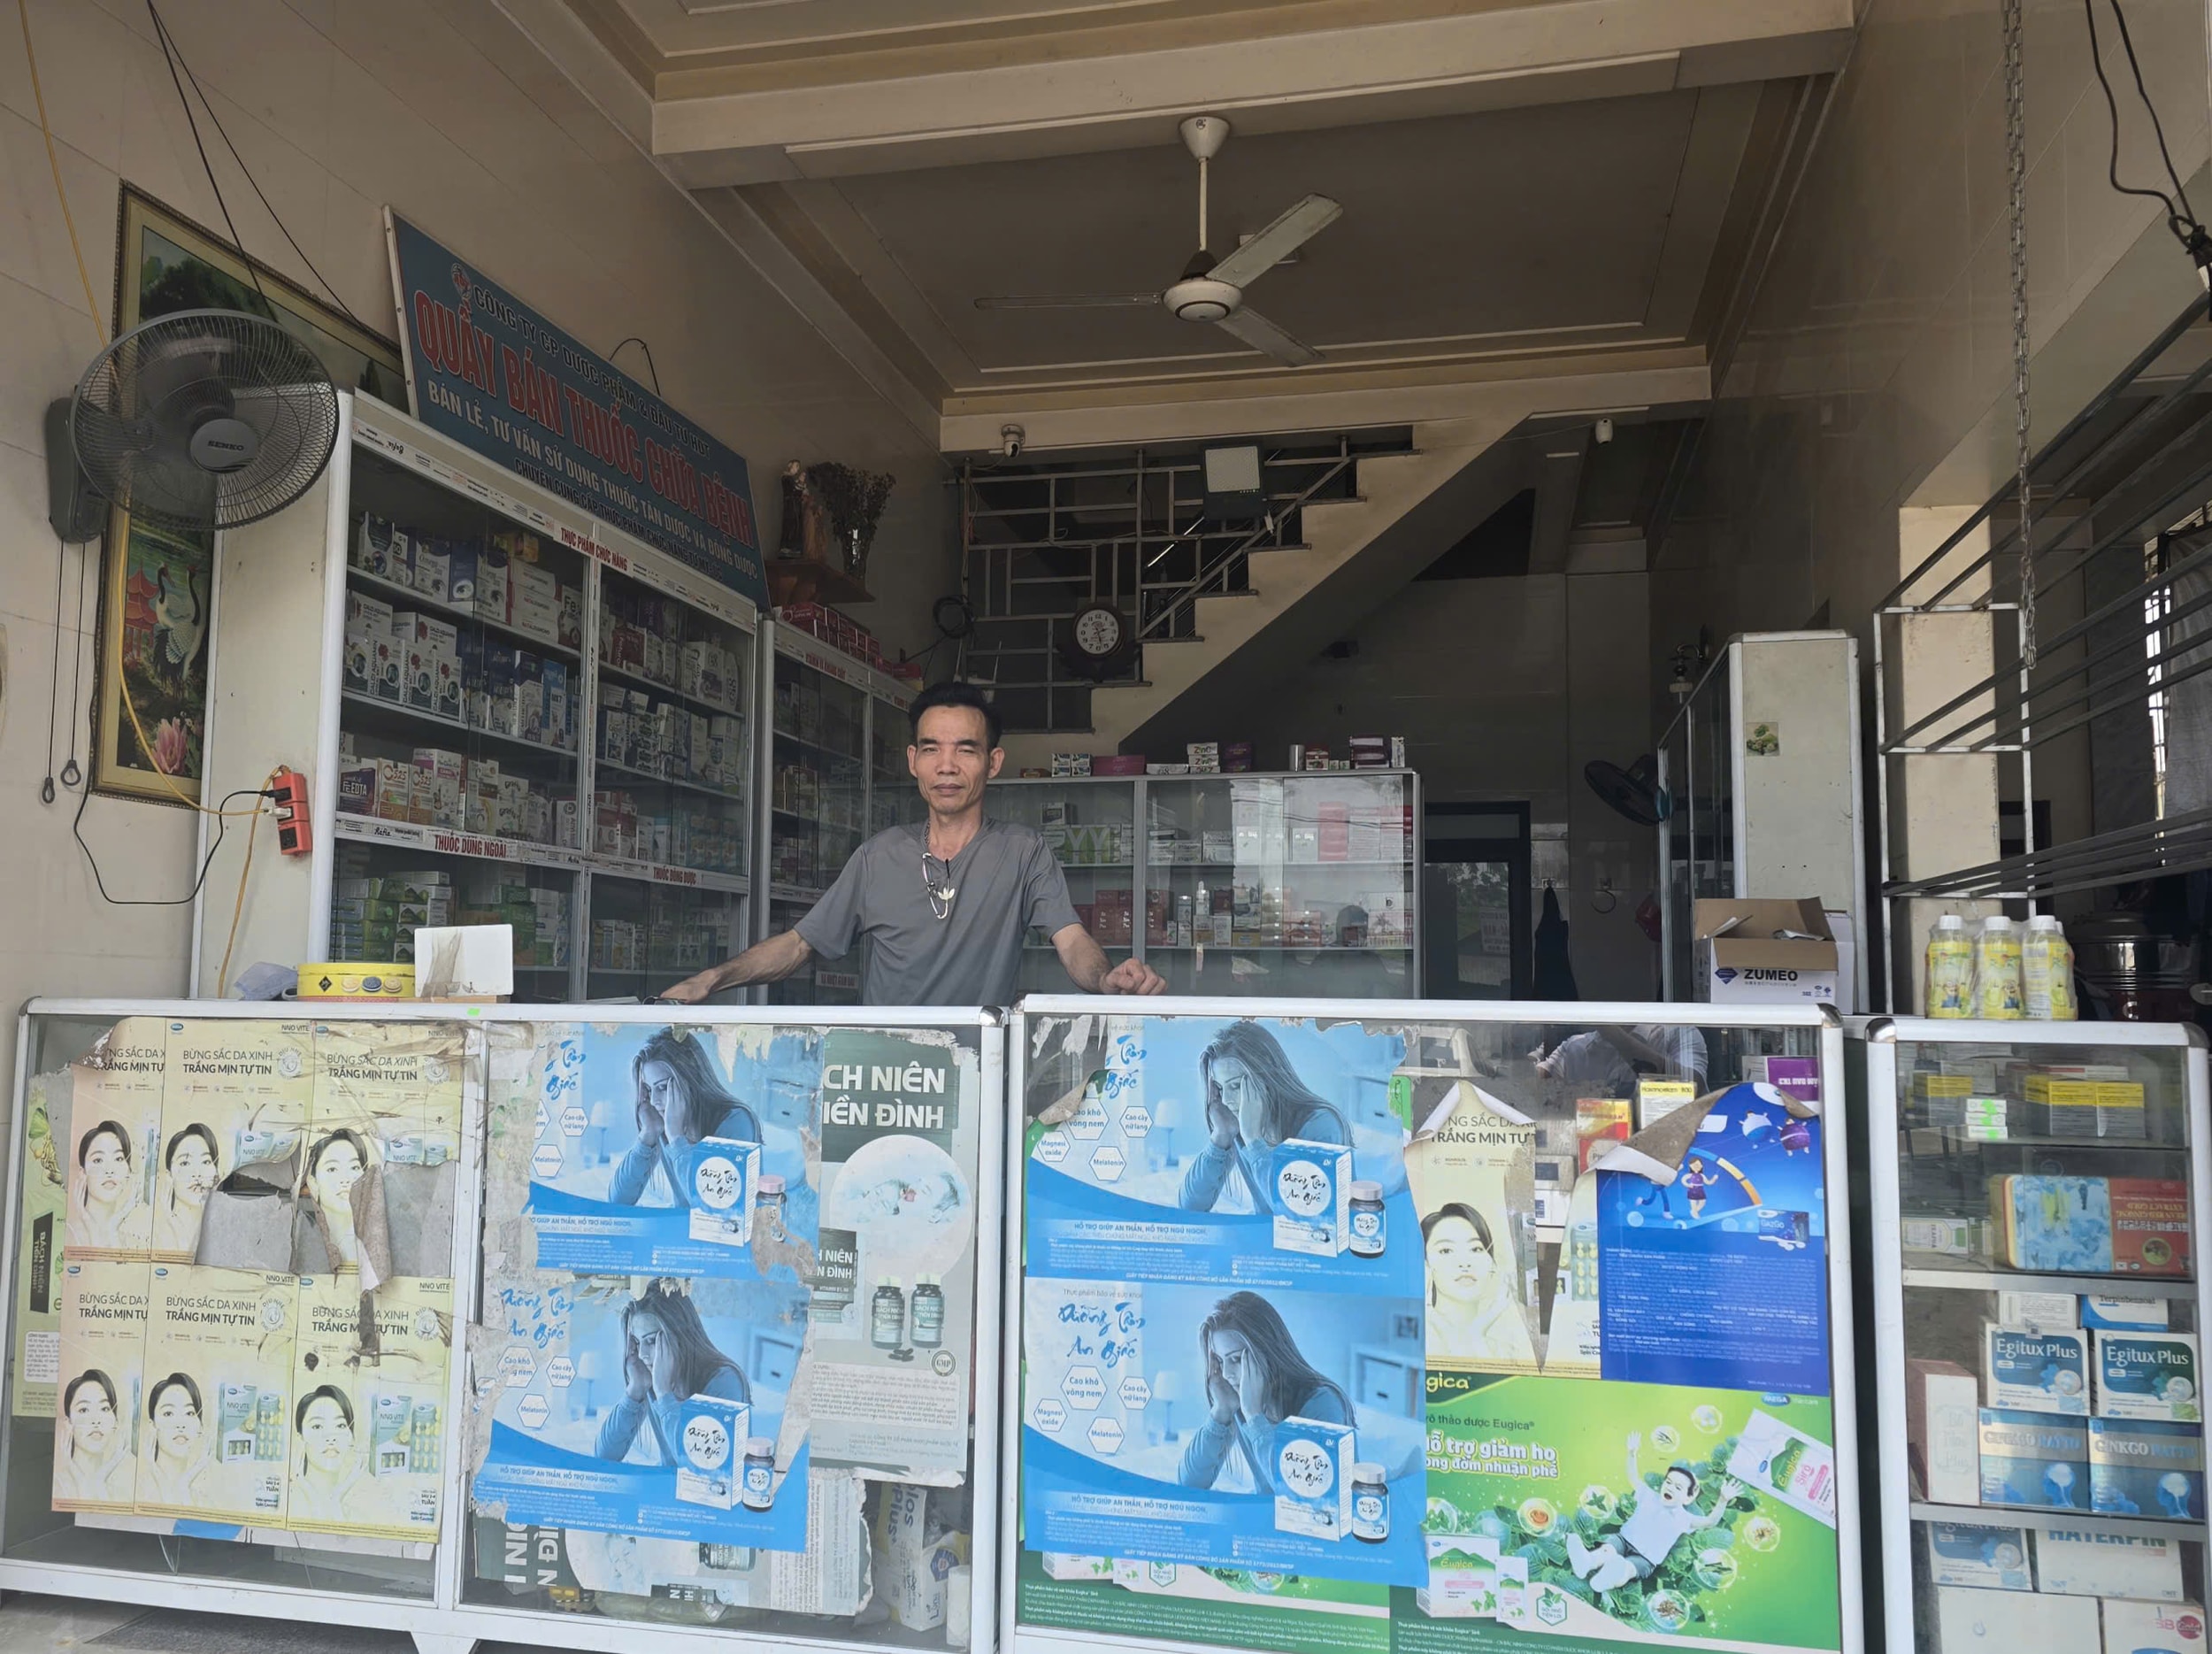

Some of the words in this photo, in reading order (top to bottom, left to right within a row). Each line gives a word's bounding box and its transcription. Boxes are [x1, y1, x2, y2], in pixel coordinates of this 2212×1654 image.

[473, 284, 517, 331] CÔNG
[518, 316, 537, 343] TY
[539, 330, 559, 357] CP
[562, 345, 599, 386] DƯỢC
[602, 374, 636, 412] PHẨM
[638, 398, 649, 419] &
[414, 290, 497, 398] QUẦY
[501, 342, 565, 438] BÁN
[564, 382, 644, 483] THUỐC
[644, 437, 703, 519] CHỮA
[701, 471, 755, 550] BỆNH
[427, 379, 462, 419] BÁN
[465, 399, 488, 435] LẺ,
[490, 415, 510, 442] TƯ
[512, 427, 541, 460] VẤN
[544, 444, 564, 472] SỬ
[565, 456, 600, 493] DỤNG
[601, 477, 640, 514] THUỐC
[641, 498, 663, 527] TÂN
[664, 512, 692, 545] DƯỢC
[693, 528, 707, 552] VÀ
[707, 536, 733, 565] ĐÔNG
[733, 556, 758, 581] DƯỢC
[514, 457, 553, 491] CHUYÊN
[553, 478, 580, 506] CUNG
[580, 492, 599, 515] CẤP
[598, 502, 621, 528] THỰC
[561, 527, 576, 550] THỰC
[577, 535, 595, 557] PHẨM
[595, 544, 611, 564] CHỨC
[611, 555, 627, 572] NĂNG
[434, 829, 459, 851] THUỐC
[461, 835, 483, 855] DÙNG
[484, 838, 507, 858] NGOÀI
[653, 865, 669, 881] THUỐC
[1744, 969, 1799, 981] ZUMEO
[183, 1050, 211, 1060] BỪNG
[213, 1048, 231, 1060] SẮC
[233, 1050, 246, 1060] DA
[248, 1050, 273, 1061] XINH
[326, 1053, 354, 1065] BỪNG
[378, 1057, 393, 1066] DA
[395, 1056, 418, 1067] XINH
[183, 1061, 215, 1073] TRẮNG
[218, 1064, 237, 1075] MỊN
[240, 1065, 255, 1075] TỰ
[256, 1065, 273, 1074] TIN
[328, 1065, 360, 1079] TRẮNG
[362, 1069, 382, 1081] MỊN
[383, 1070, 399, 1081] TỰ
[401, 1070, 418, 1081] TIN
[824, 1065, 863, 1092] CH
[871, 1060, 946, 1094] NIÊN
[824, 1096, 869, 1127] IỀN
[875, 1098, 944, 1129] ĐÌNH
[1471, 1112, 1497, 1128] SẮC
[1479, 1132, 1507, 1148] MỊN
[1509, 1132, 1531, 1148] TỰ
[826, 1247, 854, 1263] NIÊN
[826, 1266, 852, 1280] ĐÌNH
[80, 1294, 107, 1304] BỪNG
[109, 1293, 127, 1305] SẮC
[129, 1295, 142, 1305] DA
[166, 1296, 195, 1307] BỪNG
[196, 1296, 215, 1308] SẮC
[217, 1298, 230, 1309] DA
[232, 1299, 256, 1311] XINH
[80, 1306, 111, 1319] TRẮNG
[114, 1309, 134, 1320] MỊN
[165, 1309, 199, 1322] TRẮNG
[201, 1312, 221, 1325] MỊN
[223, 1313, 238, 1326] TỰ
[239, 1315, 255, 1326] TIN
[312, 1306, 342, 1318] BỪNG
[384, 1310, 409, 1320] XINH
[1115, 1302, 1147, 1334] Tâm
[312, 1319, 348, 1333] TRẮNG
[391, 1325, 408, 1335] TIN
[1066, 1335, 1094, 1358] An
[1996, 1337, 2044, 1360] Egitux
[2047, 1340, 2078, 1359] Plus
[2106, 1345, 2154, 1367] Egitux
[2157, 1348, 2189, 1367] Plus
[1069, 1375, 1084, 1385] Cao
[1085, 1375, 1099, 1386] khô
[1136, 1384, 1147, 1394] cây
[1133, 1395, 1147, 1404] lang
[1037, 1408, 1063, 1417] Magnesi
[1439, 1413, 1463, 1426] thảo
[1463, 1416, 1491, 1428] dược
[1091, 1429, 1123, 1439] Melatonin
[1446, 1435, 1477, 1458] trợ
[1479, 1439, 1528, 1462] giảm
[1531, 1442, 1557, 1462] ho
[2095, 1438, 2149, 1457] GINKGO
[1425, 1458, 1451, 1472] ong
[1452, 1456, 1483, 1473] đờm
[1485, 1460, 1529, 1478] nhuận
[1532, 1460, 1559, 1481] phế
